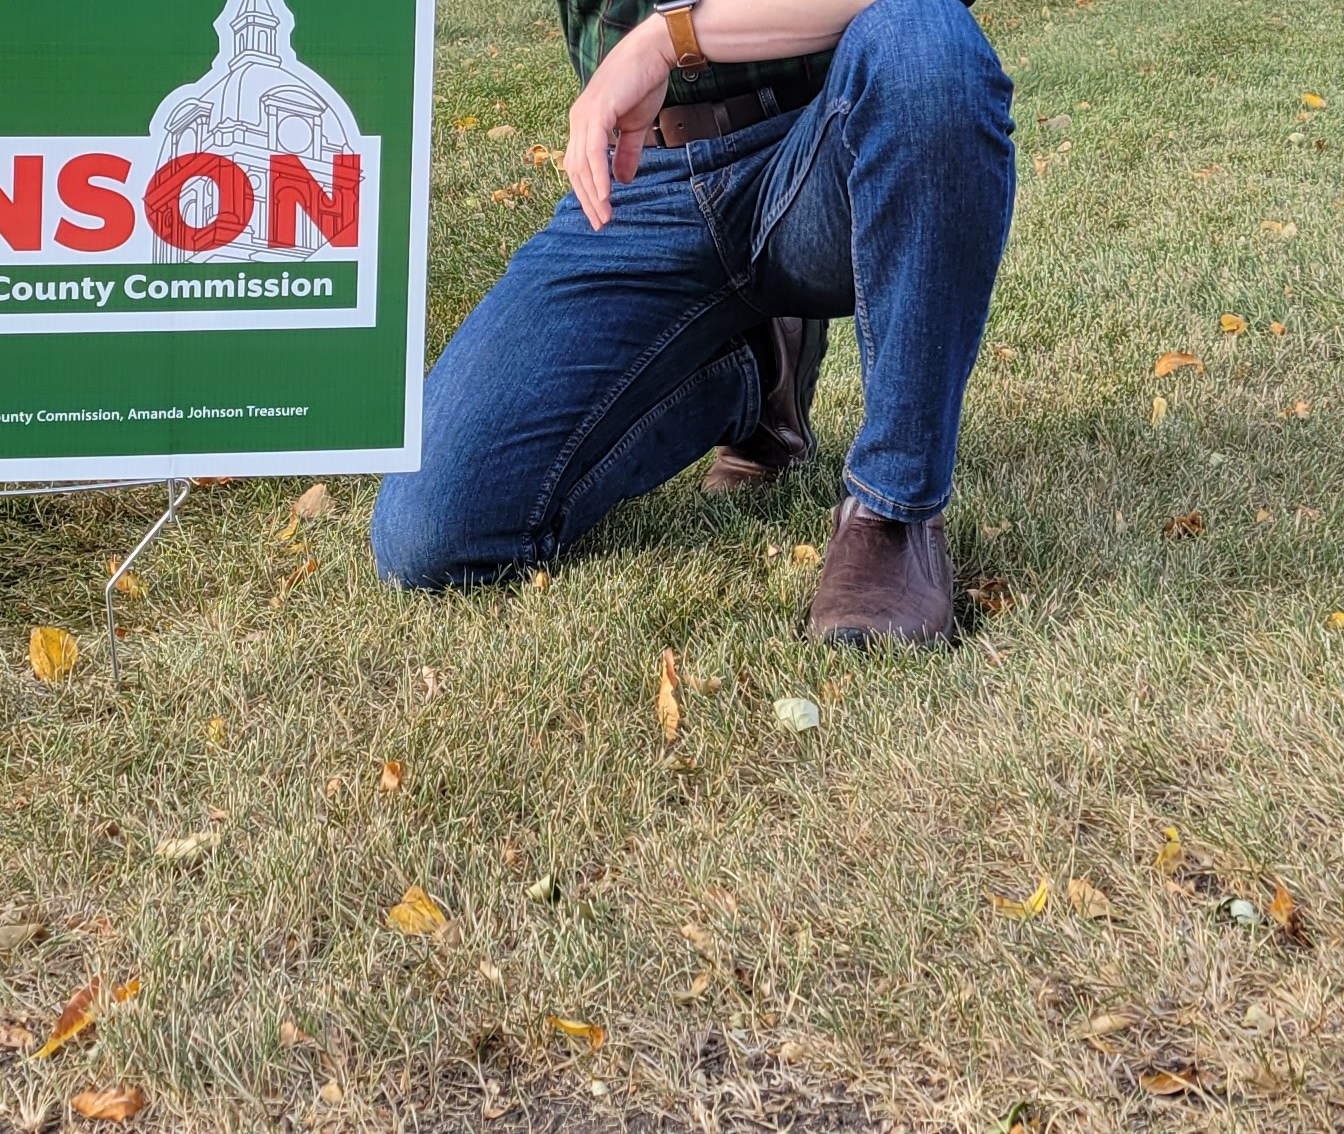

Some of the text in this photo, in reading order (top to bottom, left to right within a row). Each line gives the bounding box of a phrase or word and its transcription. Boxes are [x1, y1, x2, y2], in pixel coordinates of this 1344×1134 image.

[123, 272, 334, 302] Commission
[36, 408, 124, 422] Commission,
[127, 407, 184, 420] Amanda
[187, 406, 244, 419] Johnson
[246, 405, 309, 417] Treasurer
